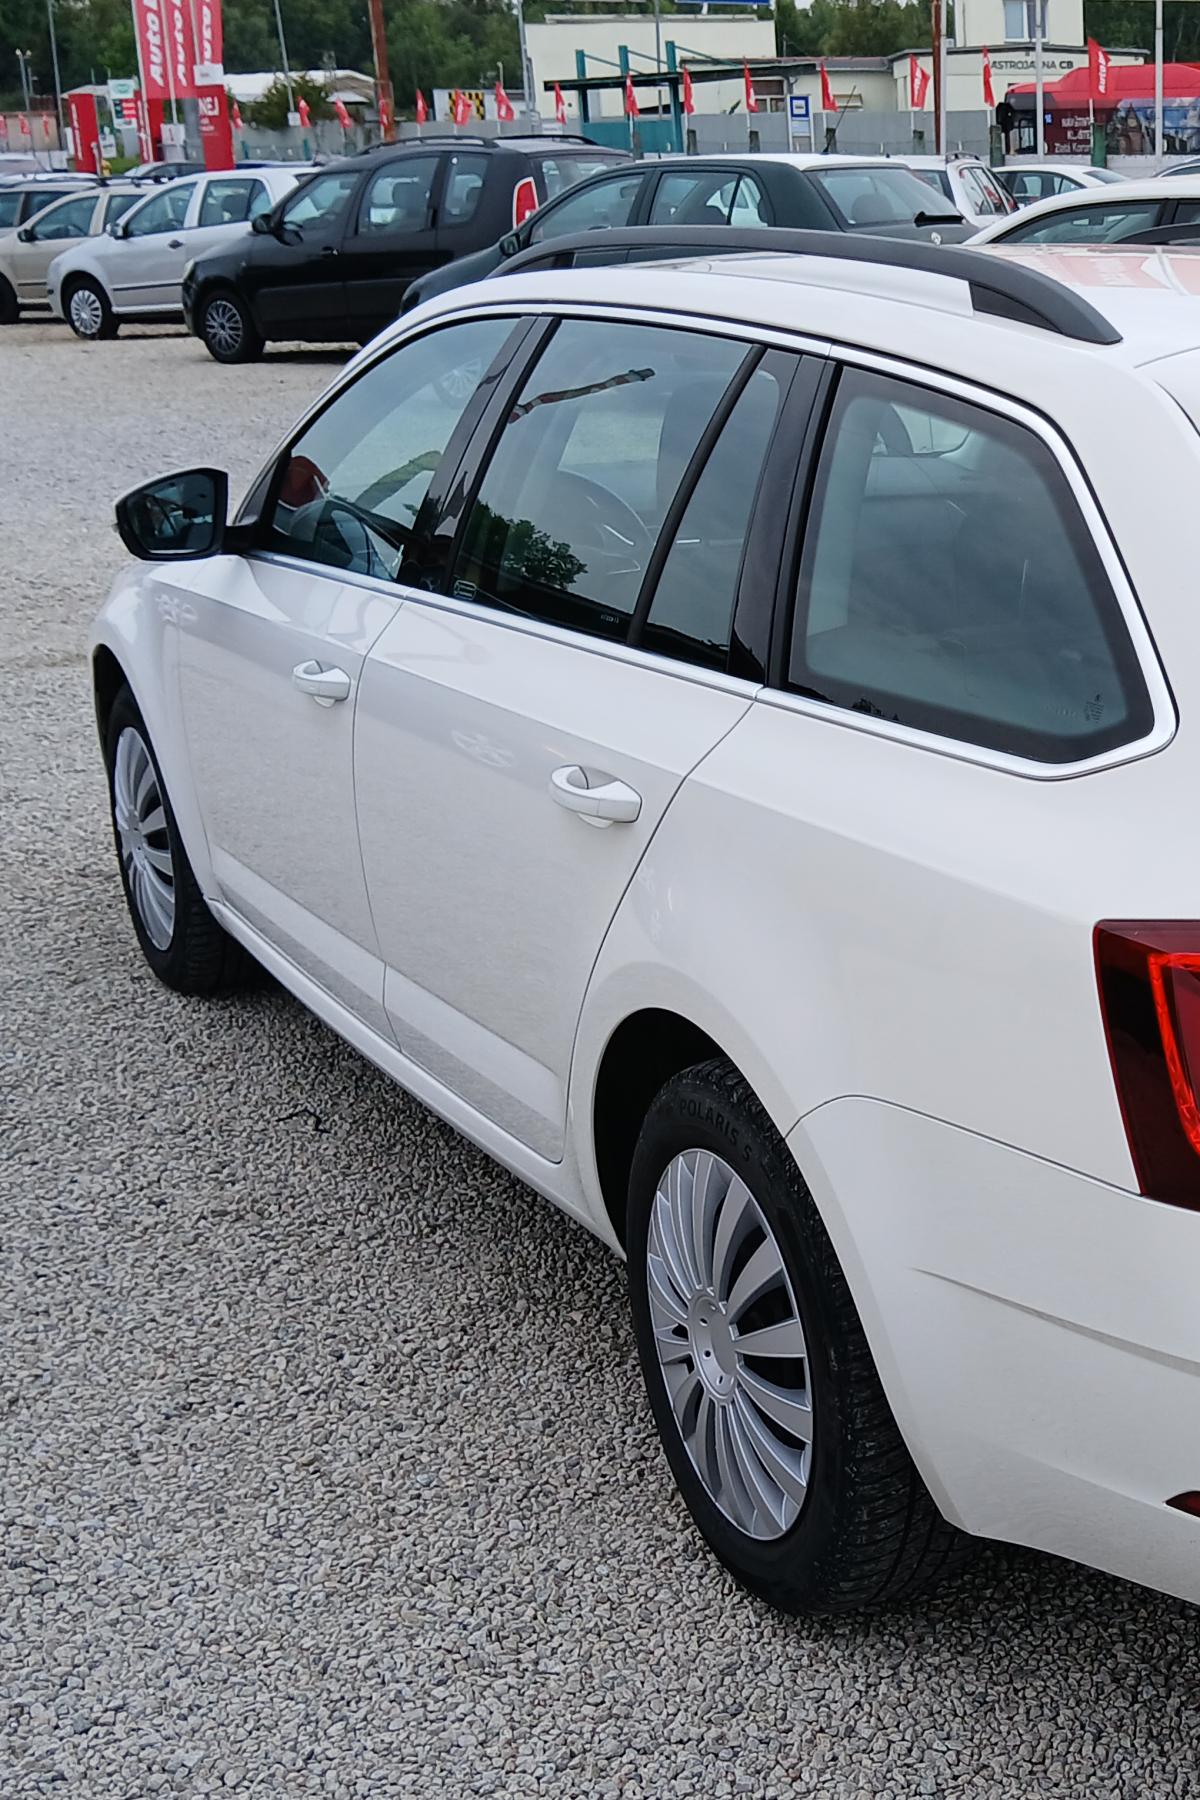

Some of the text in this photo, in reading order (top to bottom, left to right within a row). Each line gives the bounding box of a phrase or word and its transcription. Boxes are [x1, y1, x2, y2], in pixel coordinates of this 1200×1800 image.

[146, 11, 165, 88] Auto
[1059, 60, 1074, 70] CB
[198, 96, 220, 116] NEJ
[679, 1098, 739, 1146] POLARIS
